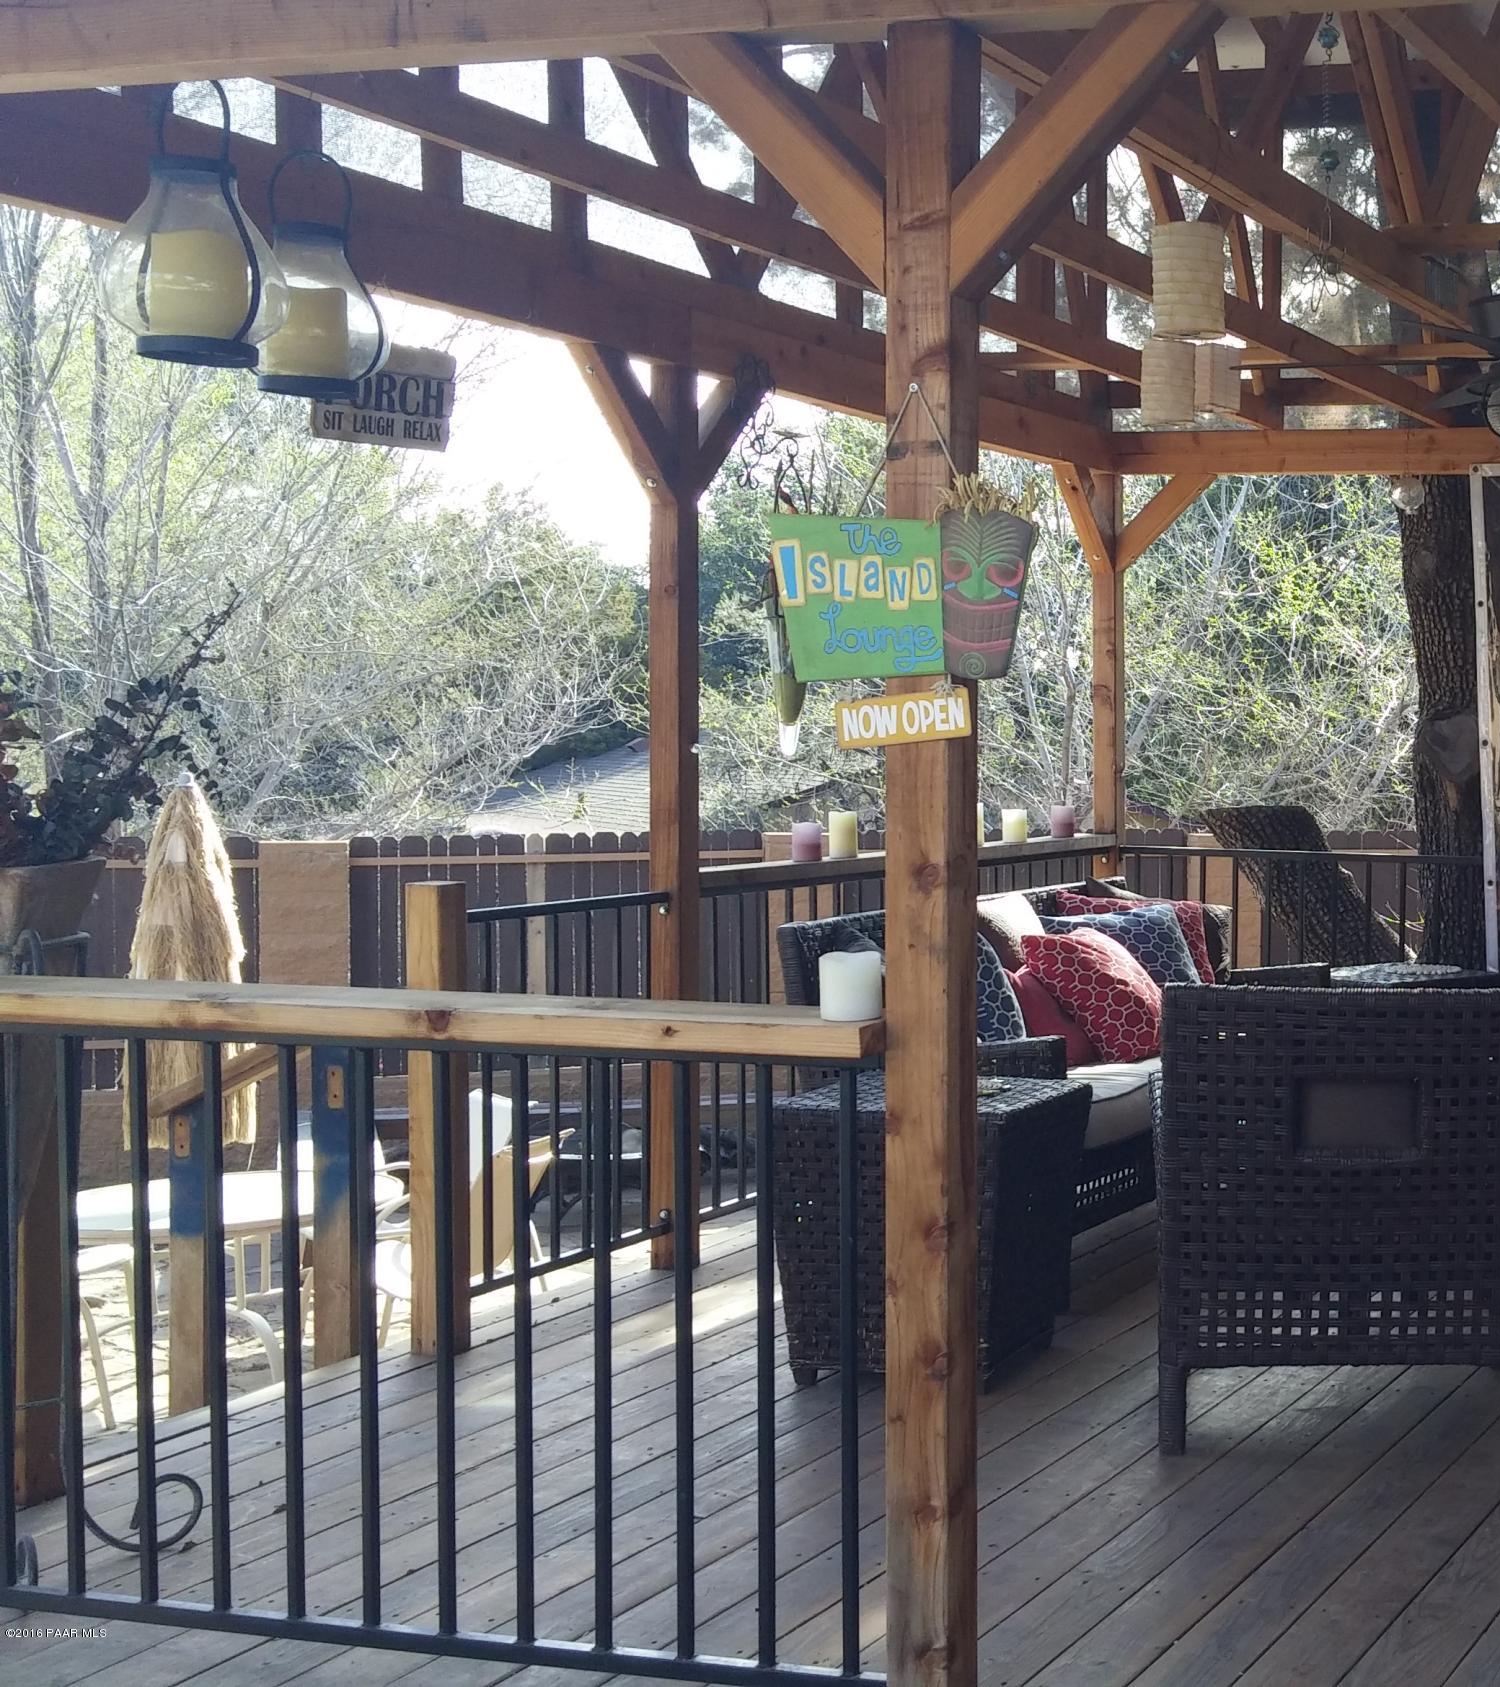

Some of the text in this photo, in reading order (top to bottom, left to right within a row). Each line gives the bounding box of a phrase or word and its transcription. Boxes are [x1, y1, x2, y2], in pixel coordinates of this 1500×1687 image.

[324, 372, 445, 419] ORCH
[322, 410, 442, 442] SIT LAUGH RELAX
[840, 522, 903, 556] The
[819, 601, 944, 672] Lounge
[841, 697, 966, 742] NOW OPEN
